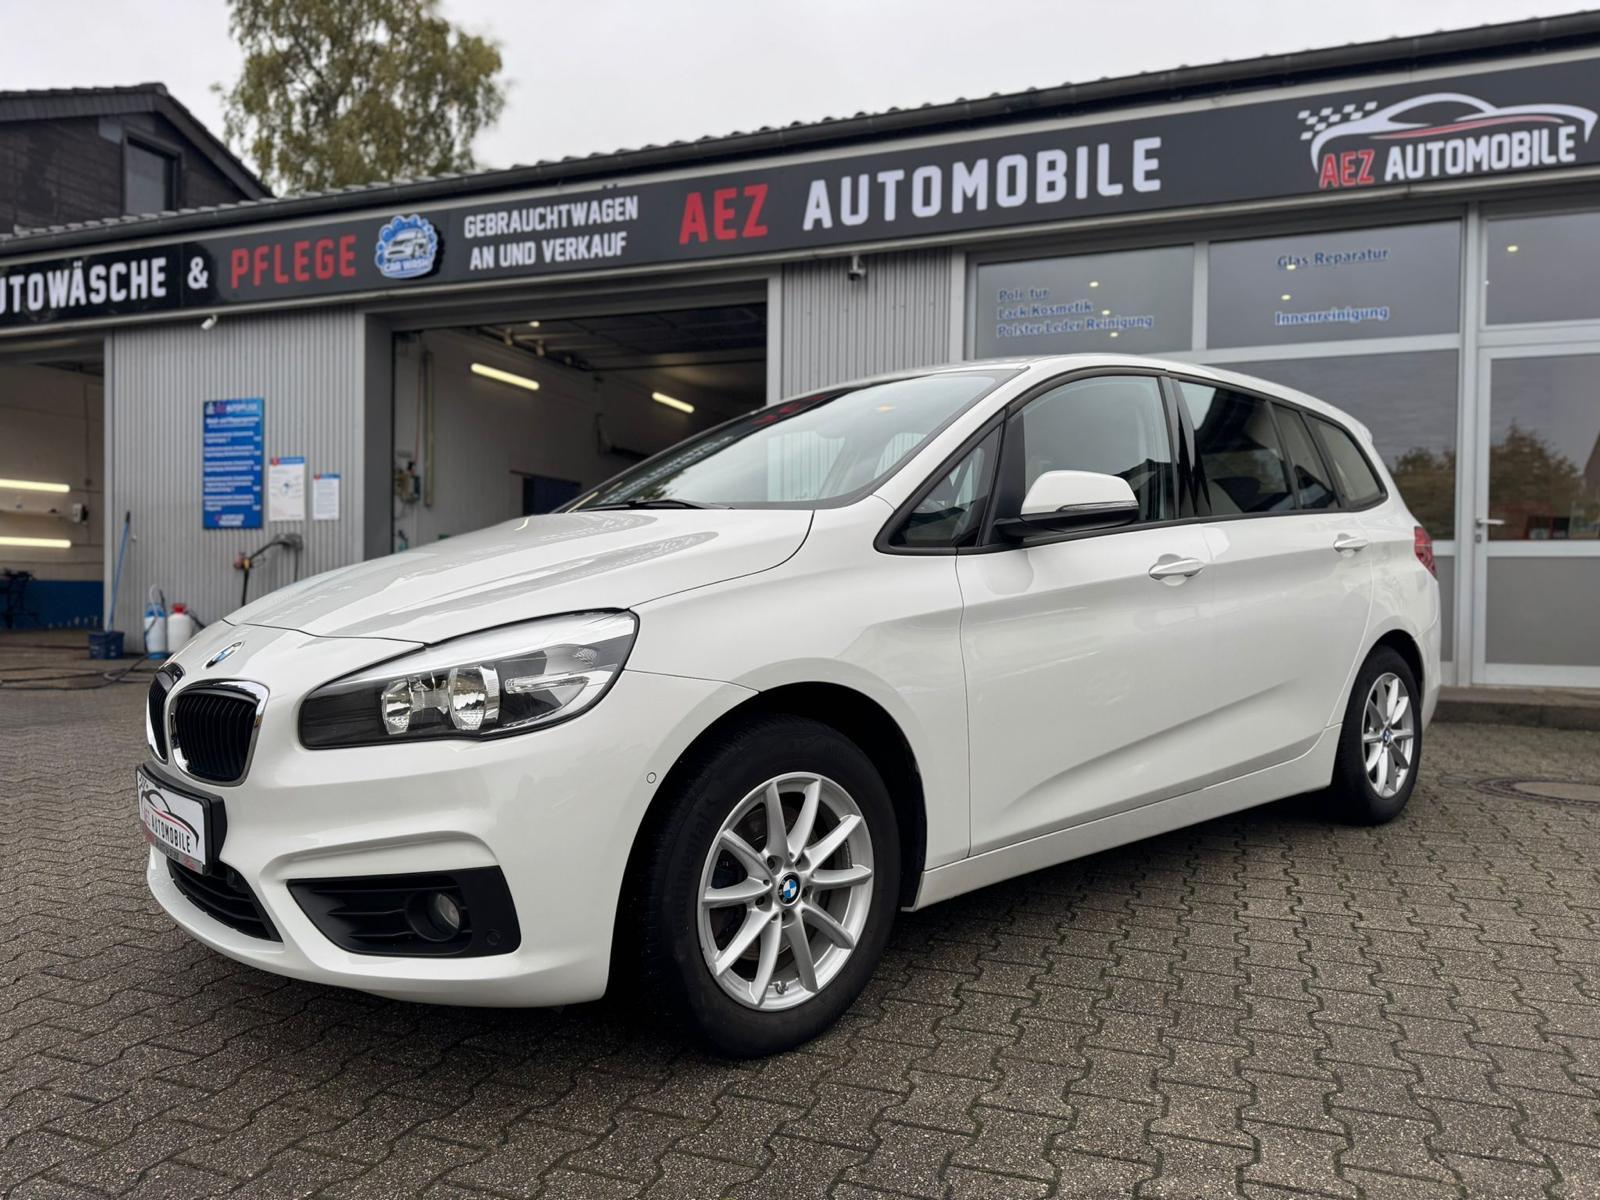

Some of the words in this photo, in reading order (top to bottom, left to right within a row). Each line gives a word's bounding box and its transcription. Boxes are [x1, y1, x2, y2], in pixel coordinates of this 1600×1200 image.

[1319, 150, 1375, 189] AEZ
[1384, 125, 1577, 182] AUTOMOBILE
[679, 183, 769, 245] AEZ
[802, 136, 1162, 231] AUTOMOBILE
[464, 195, 638, 239] GEBRAUCHTWAGEN
[187, 256, 209, 289] &
[231, 234, 357, 288] PFLEGE
[469, 245, 494, 270] AN
[499, 240, 535, 267] UND
[541, 231, 627, 264] VERKAUF
[1277, 254, 1309, 268] Glas
[1314, 248, 1388, 265] Reparatur
[1031, 299, 1094, 316] Kosmetik
[1086, 314, 1153, 331] Reinigung
[1275, 306, 1390, 325] Innenreinigung
[151, 814, 191, 854] AUTOMOBILE
